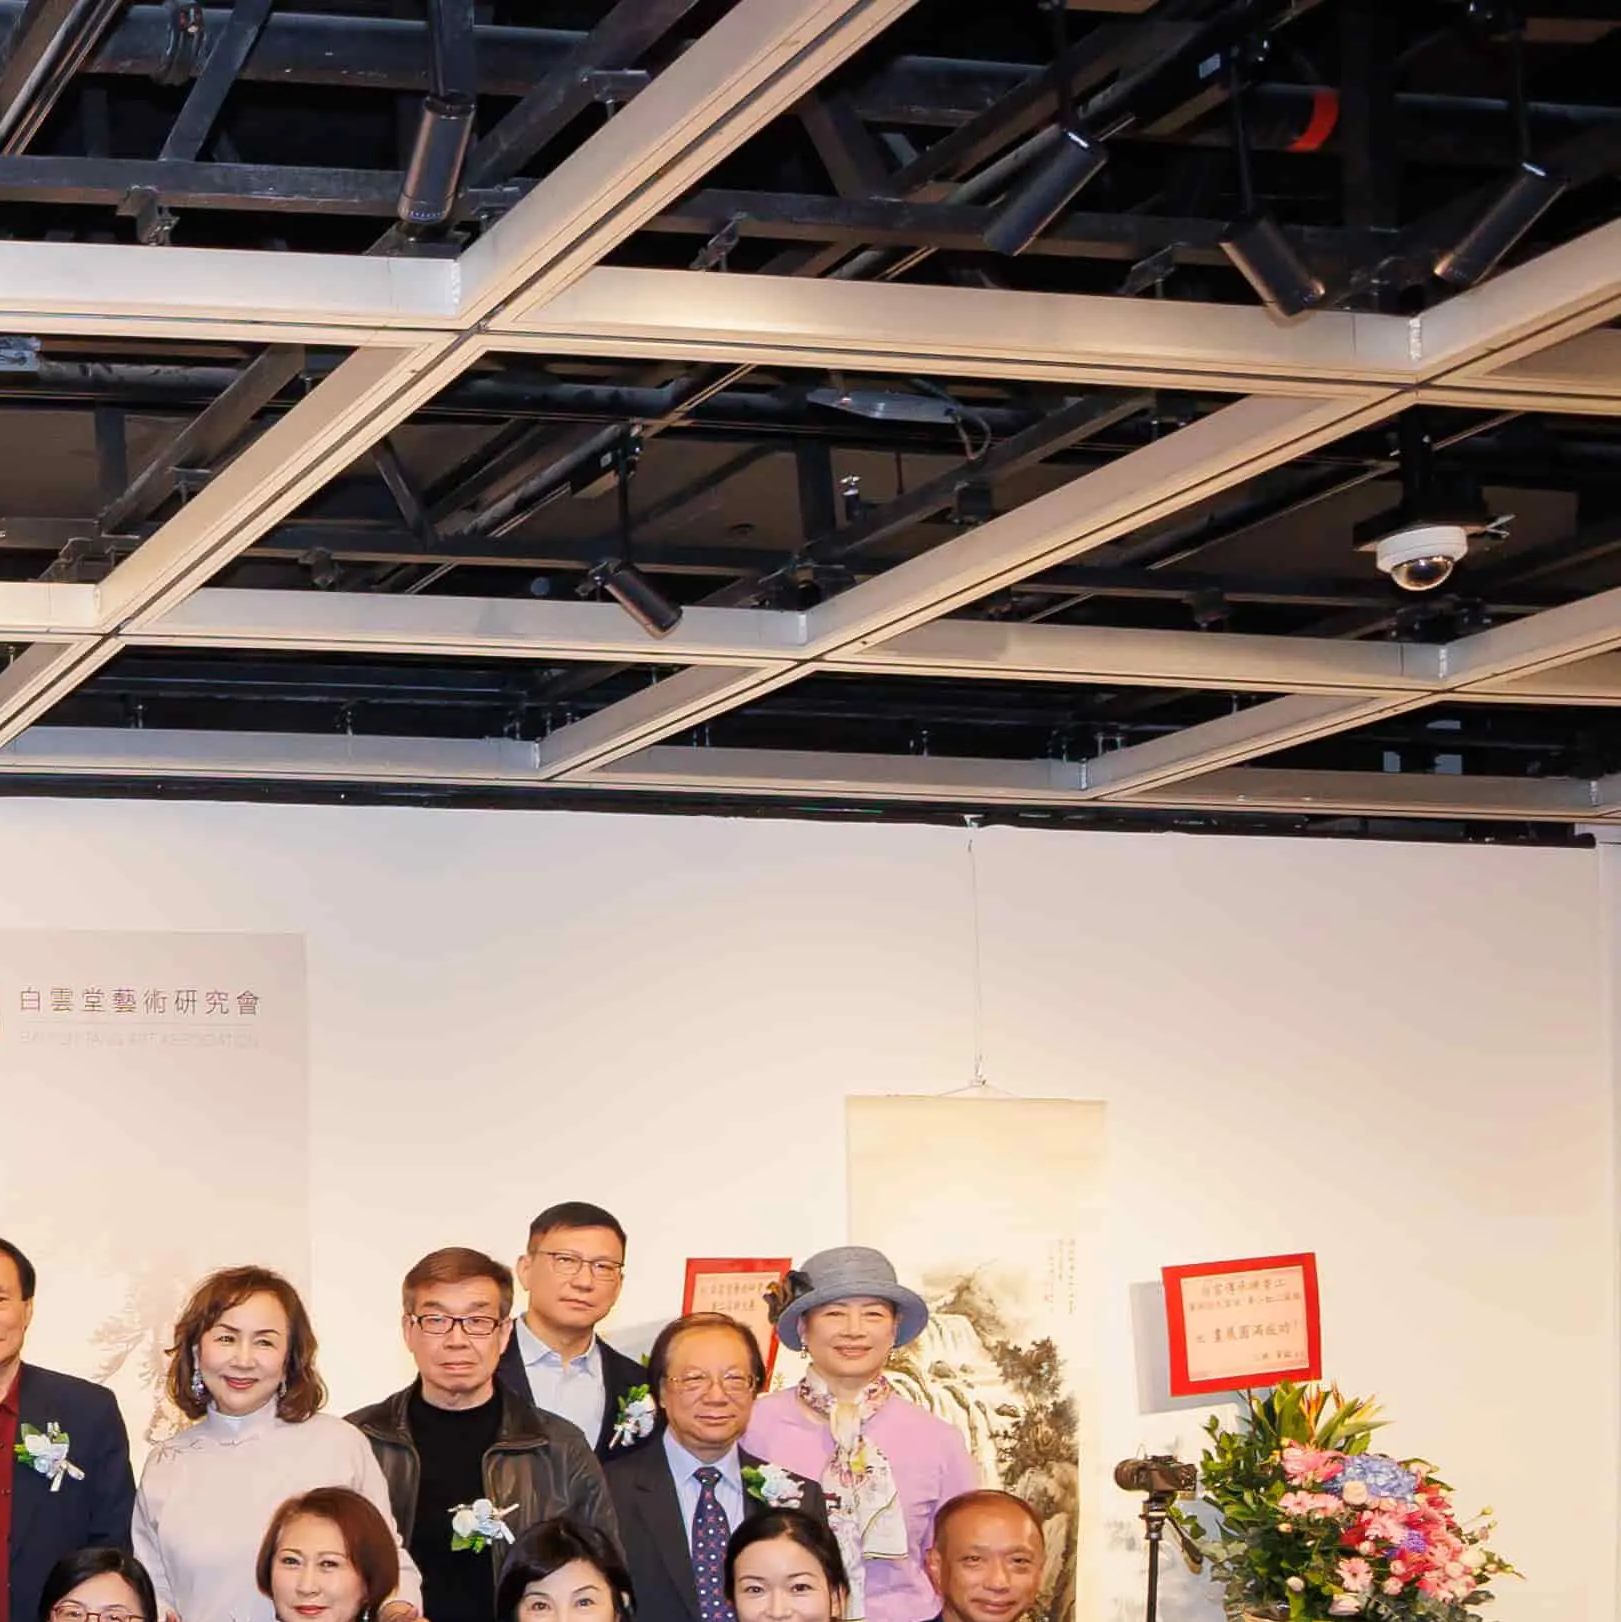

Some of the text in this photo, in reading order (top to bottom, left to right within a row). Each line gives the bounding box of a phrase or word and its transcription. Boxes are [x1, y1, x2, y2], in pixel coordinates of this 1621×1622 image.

[20, 986, 261, 1016] 白雲堂藝術研究會
